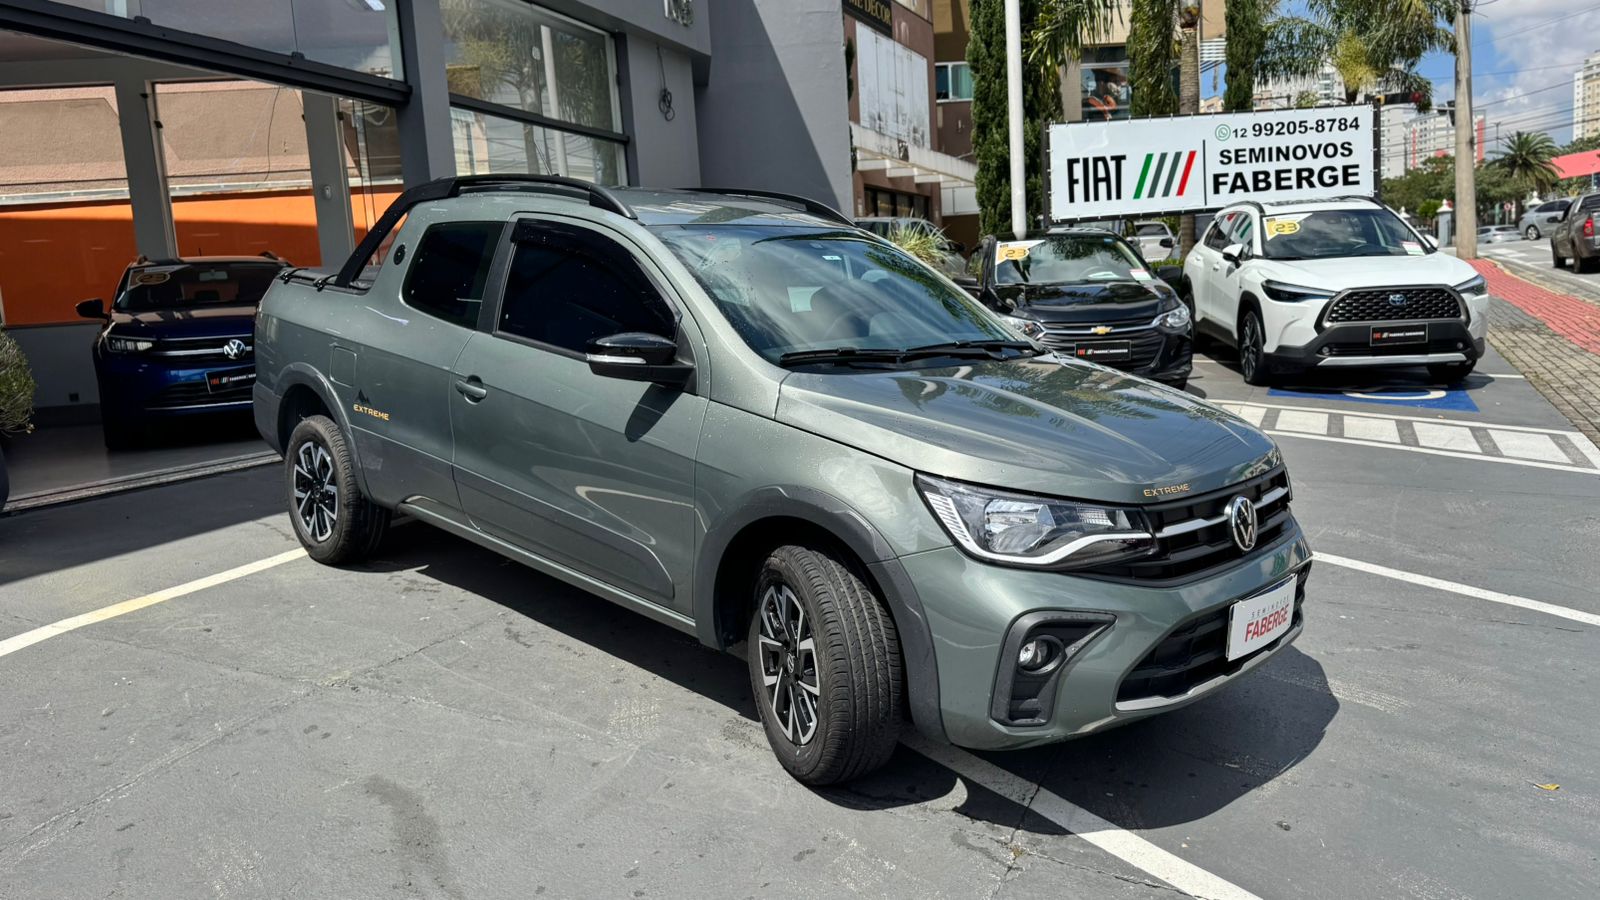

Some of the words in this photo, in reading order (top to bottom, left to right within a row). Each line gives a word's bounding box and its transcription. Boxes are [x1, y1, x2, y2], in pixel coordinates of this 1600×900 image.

[1232, 128, 1248, 139] 12
[1252, 116, 1360, 138] 99205-8784
[1218, 141, 1354, 166] SEMINOVOS
[1066, 154, 1127, 204] FIAT
[1212, 163, 1361, 195] FABERGE
[1275, 222, 1297, 232] 23
[1006, 248, 1026, 257] 23
[353, 404, 389, 420] EXTREME
[1143, 483, 1191, 497] EXTREME
[1244, 603, 1290, 643] FABERGE
